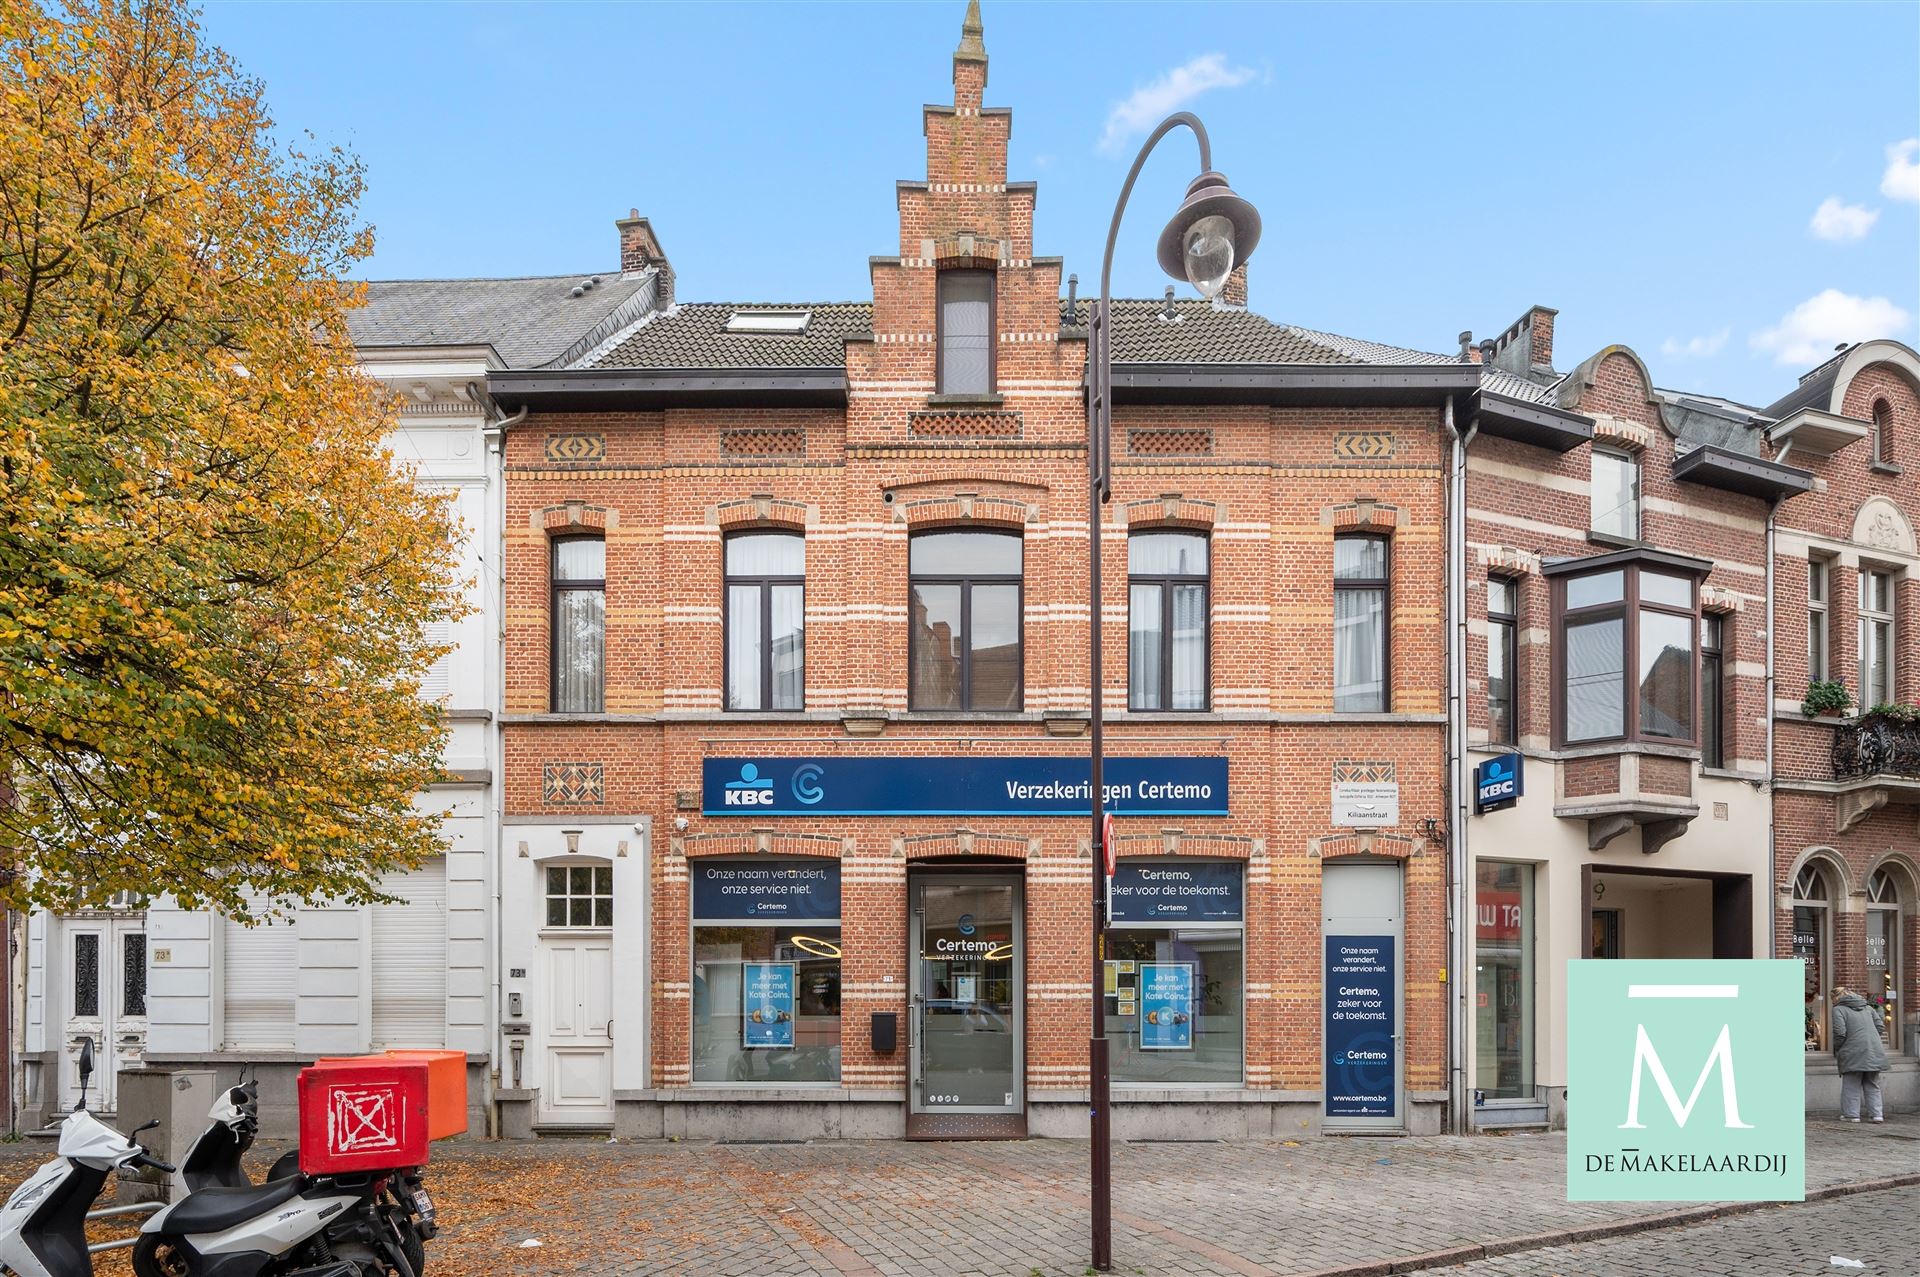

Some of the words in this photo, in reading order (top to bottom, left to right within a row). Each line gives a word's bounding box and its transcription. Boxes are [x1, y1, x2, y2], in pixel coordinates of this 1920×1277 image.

[1006, 780, 1131, 803] Verzekerigen
[1138, 780, 1211, 799] Certemo
[1480, 780, 1513, 800] KBC
[725, 789, 774, 805] KBC
[706, 868, 735, 880] Onze
[737, 870, 769, 880] naam
[771, 868, 827, 881] verandert,
[1142, 870, 1193, 882] Certemo,
[721, 885, 748, 895] onze
[749, 884, 788, 895] service
[790, 884, 812, 895] niet.
[1111, 885, 1133, 896] eker
[1135, 886, 1160, 896] voor
[1162, 885, 1177, 896] de
[1179, 885, 1231, 896] toekomst.
[936, 938, 997, 951] Certemo
[1343, 956, 1377, 964] verandert,
[768, 972, 781, 980] kan
[1154, 974, 1163, 982] Je
[1164, 974, 1178, 982] kan
[772, 982, 787, 990] met
[1168, 983, 1184, 991] met
[749, 991, 766, 999] Kate
[767, 990, 790, 999] Coins.
[1145, 992, 1163, 1000] Kate
[1164, 991, 1186, 1000] Coins.
[1340, 987, 1380, 997] Certemo,
[1337, 999, 1360, 1008] zeker
[1362, 1000, 1382, 1008] voor
[1332, 1011, 1344, 1020] de
[1346, 1011, 1387, 1020] toekomst.
[1347, 1050, 1387, 1060] Certemo
